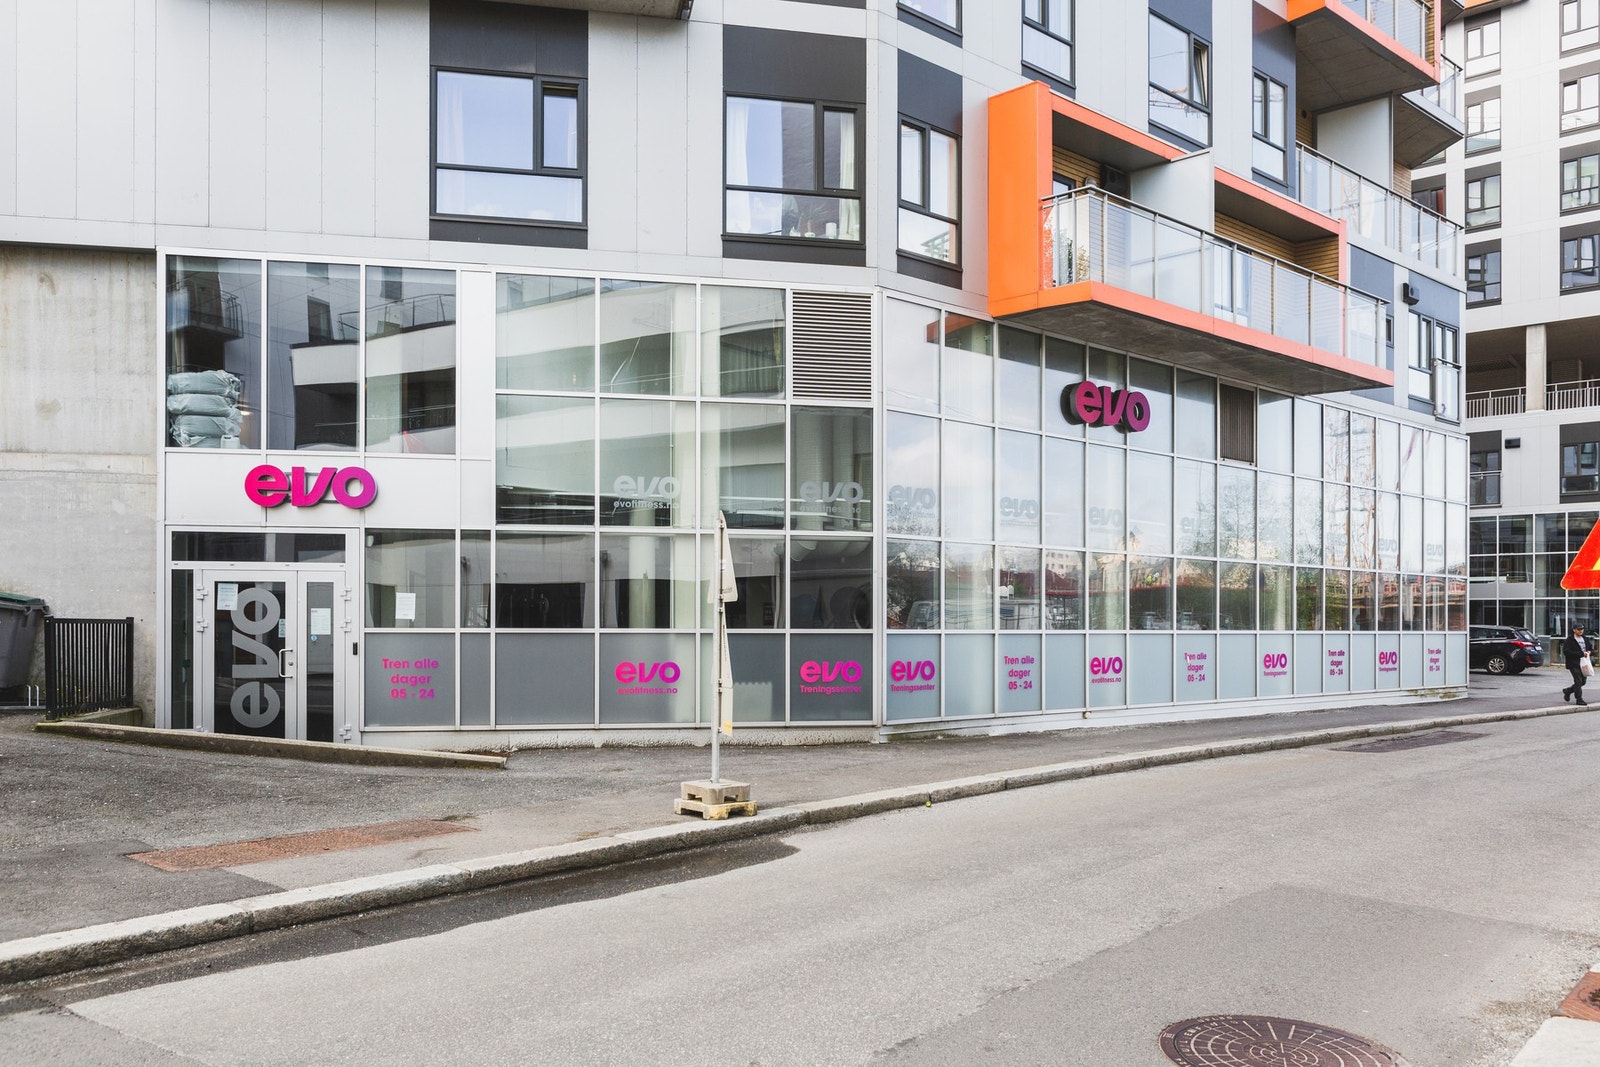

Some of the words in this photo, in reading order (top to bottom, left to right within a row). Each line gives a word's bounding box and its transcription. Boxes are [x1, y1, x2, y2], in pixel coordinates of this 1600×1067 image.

[1075, 381, 1151, 432] evo
[244, 464, 377, 509] evo
[613, 475, 681, 499] evo
[800, 481, 863, 502] evo
[888, 484, 936, 509] evo
[999, 496, 1039, 519] evo
[1088, 506, 1123, 526] evo
[230, 587, 281, 728] evo
[382, 657, 410, 669] Tren
[414, 657, 439, 669] alle
[1004, 655, 1019, 665] Tren
[1021, 655, 1035, 665] alle
[1090, 656, 1124, 675] evo
[1263, 653, 1288, 669] evo
[1378, 651, 1398, 665] evo
[390, 673, 431, 687] dager
[615, 661, 681, 684] evo
[800, 660, 863, 683] evo
[890, 660, 936, 681] evo
[1008, 668, 1031, 679] dager
[390, 687, 407, 699] 05
[418, 687, 435, 699] 24
[617, 686, 678, 695] evofitness.no
[800, 684, 862, 695] Treningssenter
[890, 684, 936, 693] Treningssenter
[1008, 681, 1018, 690] 05
[1023, 680, 1033, 690] 24
